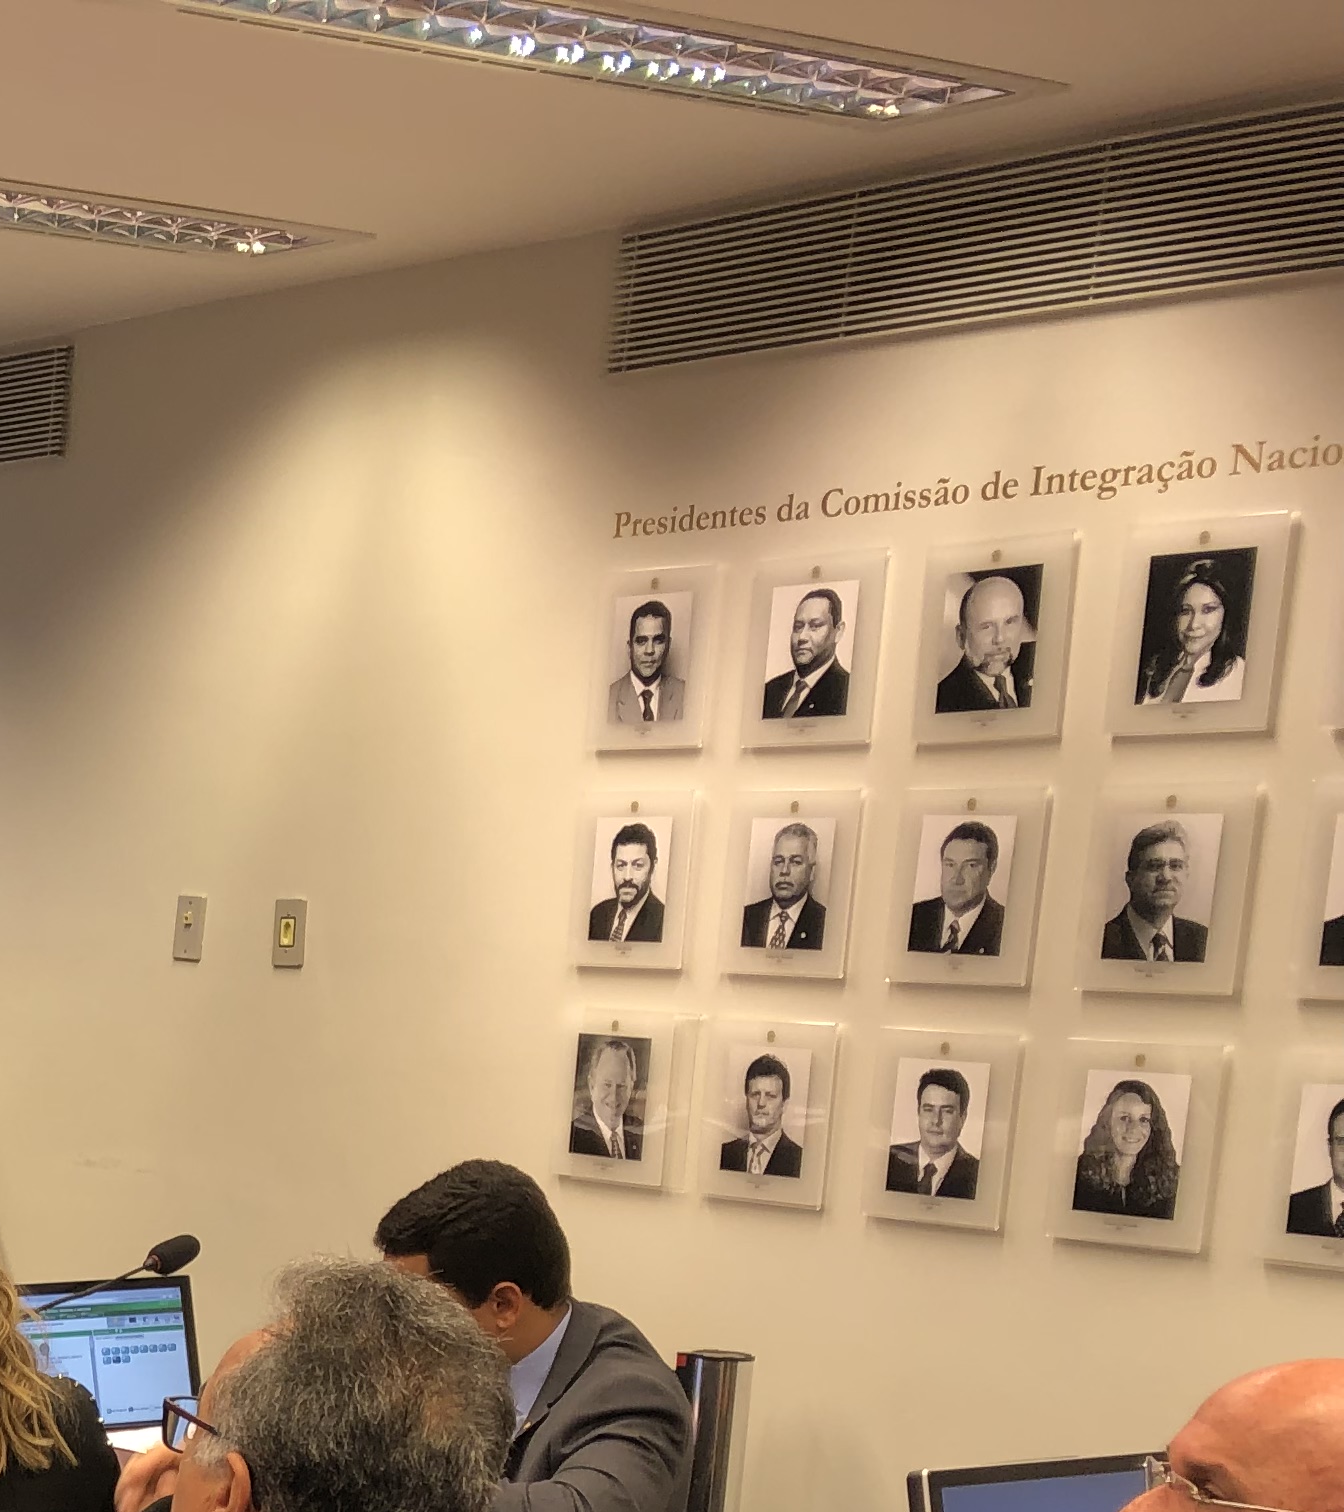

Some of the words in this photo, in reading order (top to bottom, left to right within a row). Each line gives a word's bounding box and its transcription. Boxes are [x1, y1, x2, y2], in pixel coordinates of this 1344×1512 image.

[613, 501, 767, 539] Presidentes
[776, 493, 810, 524] da
[821, 476, 970, 518] Comissão
[981, 470, 1019, 502] de
[1030, 450, 1218, 500] Integração
